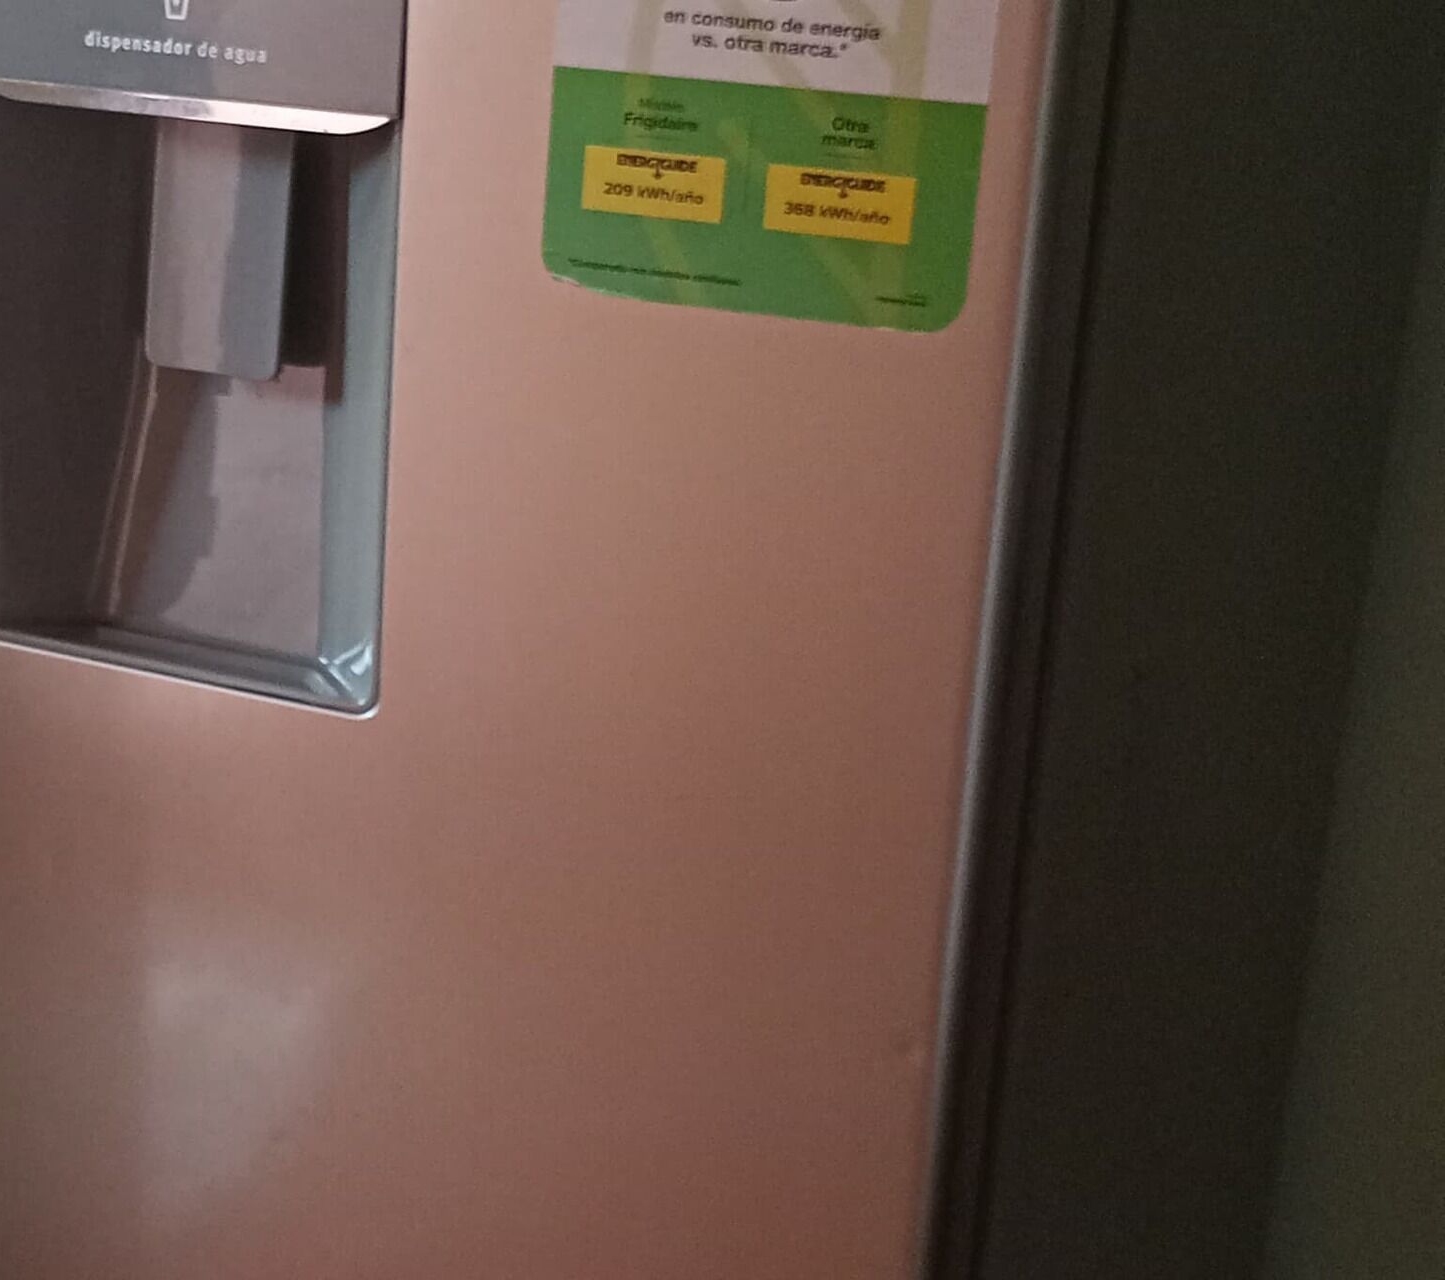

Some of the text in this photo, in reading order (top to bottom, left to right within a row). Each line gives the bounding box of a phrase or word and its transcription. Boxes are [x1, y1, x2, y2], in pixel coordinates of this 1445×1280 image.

[663, 10, 882, 43] en consumo de energía
[84, 30, 268, 65] dispensador de agua
[691, 33, 718, 49] vs.
[723, 35, 764, 53] otra
[623, 112, 699, 132] Frigidaire
[831, 116, 870, 134] Otra
[821, 133, 877, 150] marca
[602, 181, 705, 206] 209 kWh/año
[819, 205, 892, 226] kWh/año
